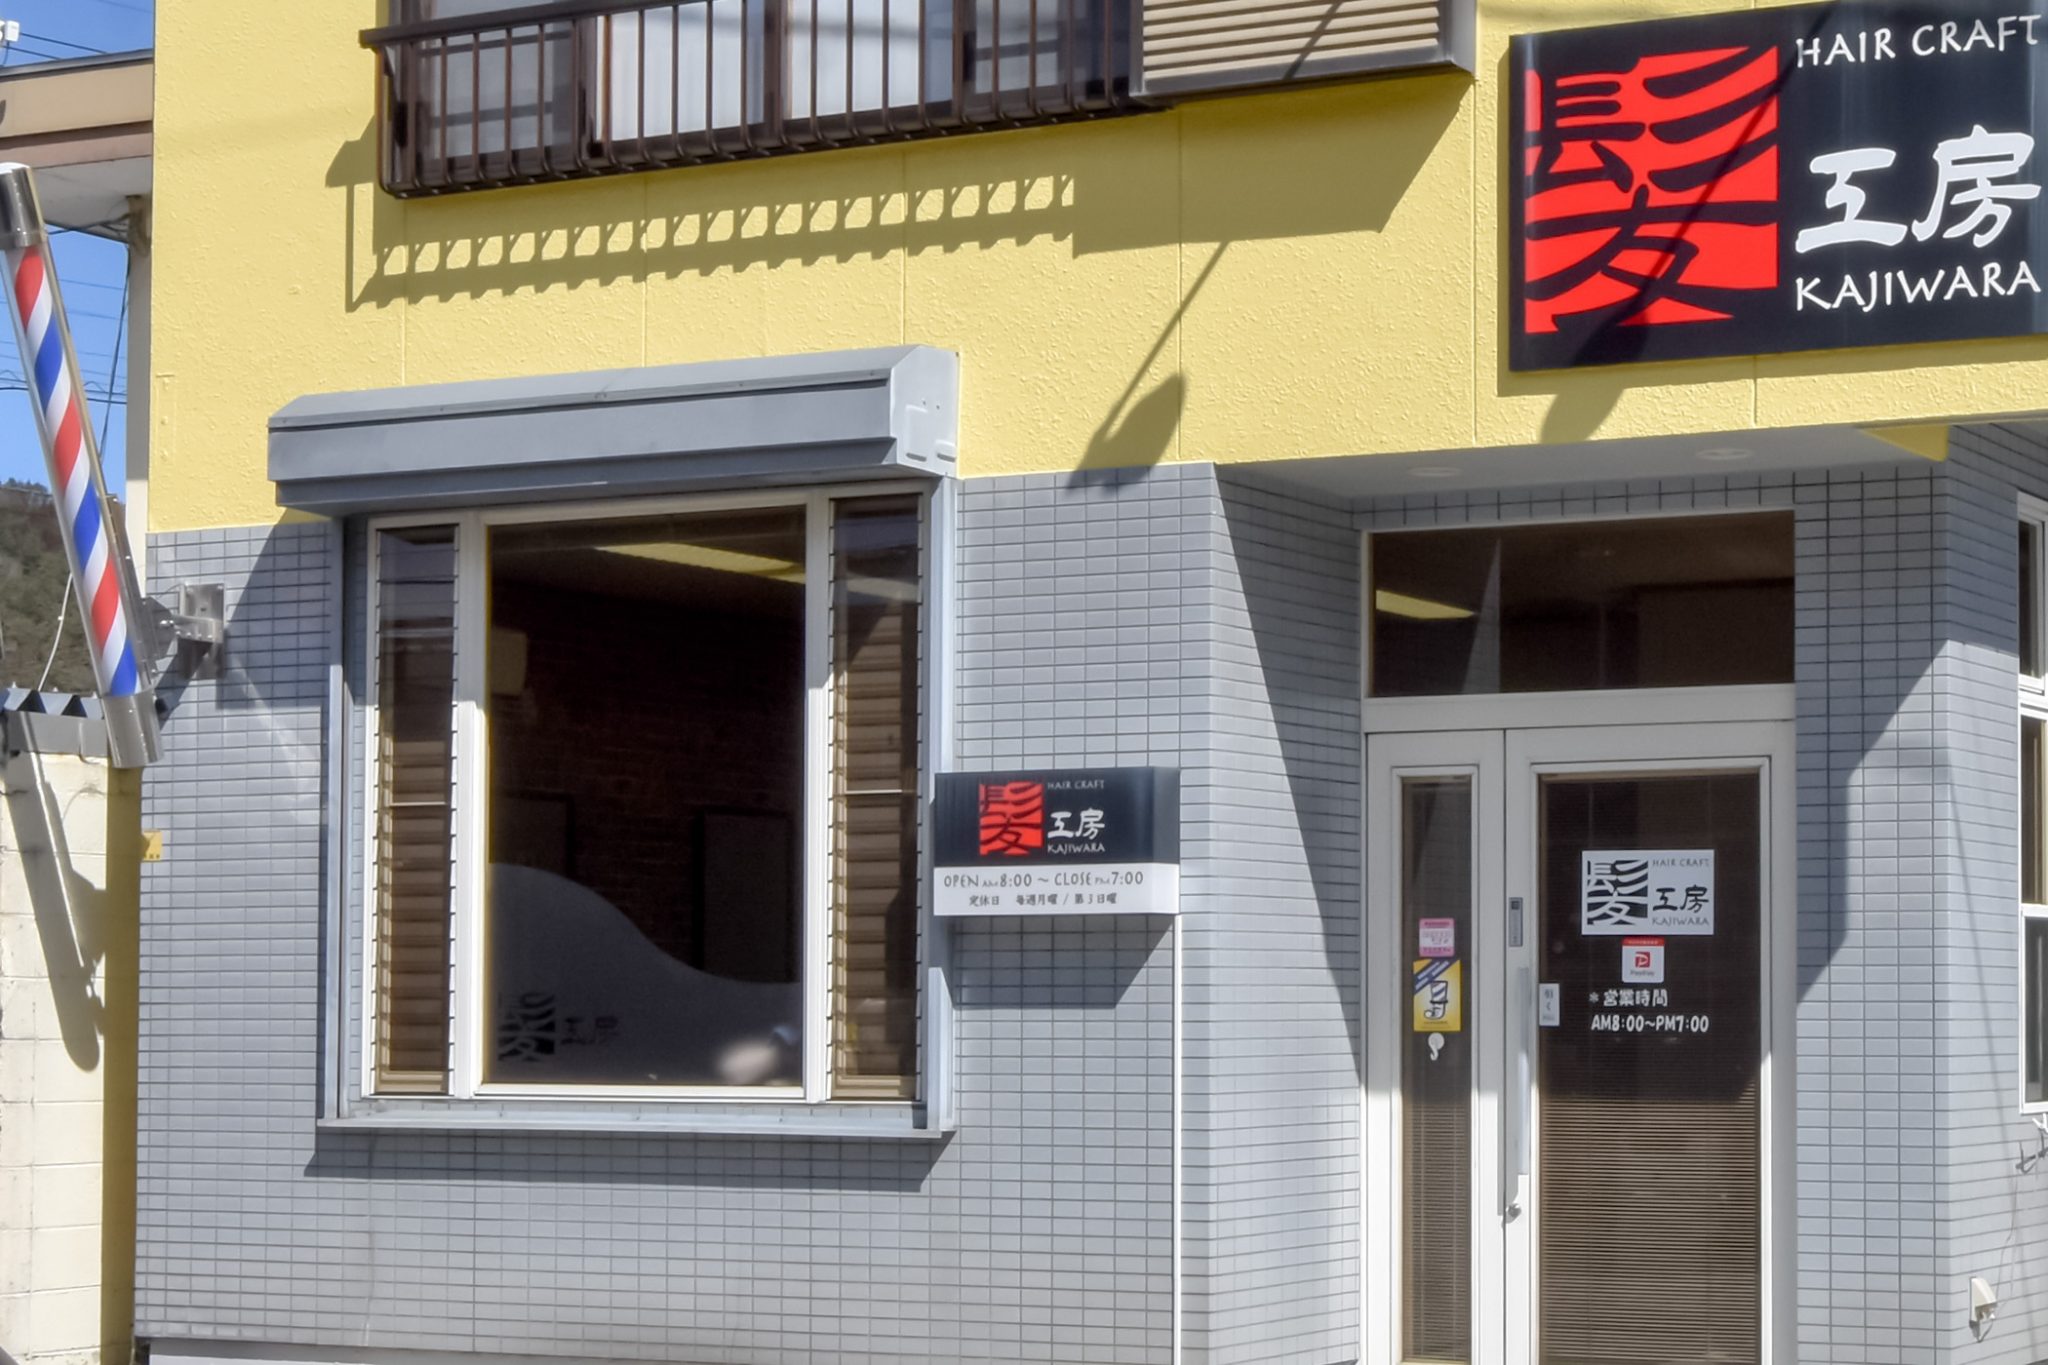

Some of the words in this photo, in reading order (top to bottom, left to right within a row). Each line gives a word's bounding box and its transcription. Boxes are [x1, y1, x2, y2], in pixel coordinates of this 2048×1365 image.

[1797, 27, 1897, 68] HAIR
[1911, 14, 2041, 57] CRAFT
[1795, 124, 2042, 254] 工房
[1795, 260, 2041, 312] KAJIWARA
[1048, 781, 1071, 790] HAIR
[1074, 779, 1104, 790] CRAFT
[1047, 807, 1105, 840] 工房
[1047, 843, 1105, 854] KAJIWARA
[1652, 859, 1676, 867] HAIR
[1679, 858, 1710, 867] CRAFT
[944, 874, 979, 888] OPEN
[1054, 872, 1091, 886] CLOSE
[969, 895, 1000, 907] 定休日
[1652, 884, 1710, 913] 工房
[1652, 917, 1709, 926] KAJIWARA
